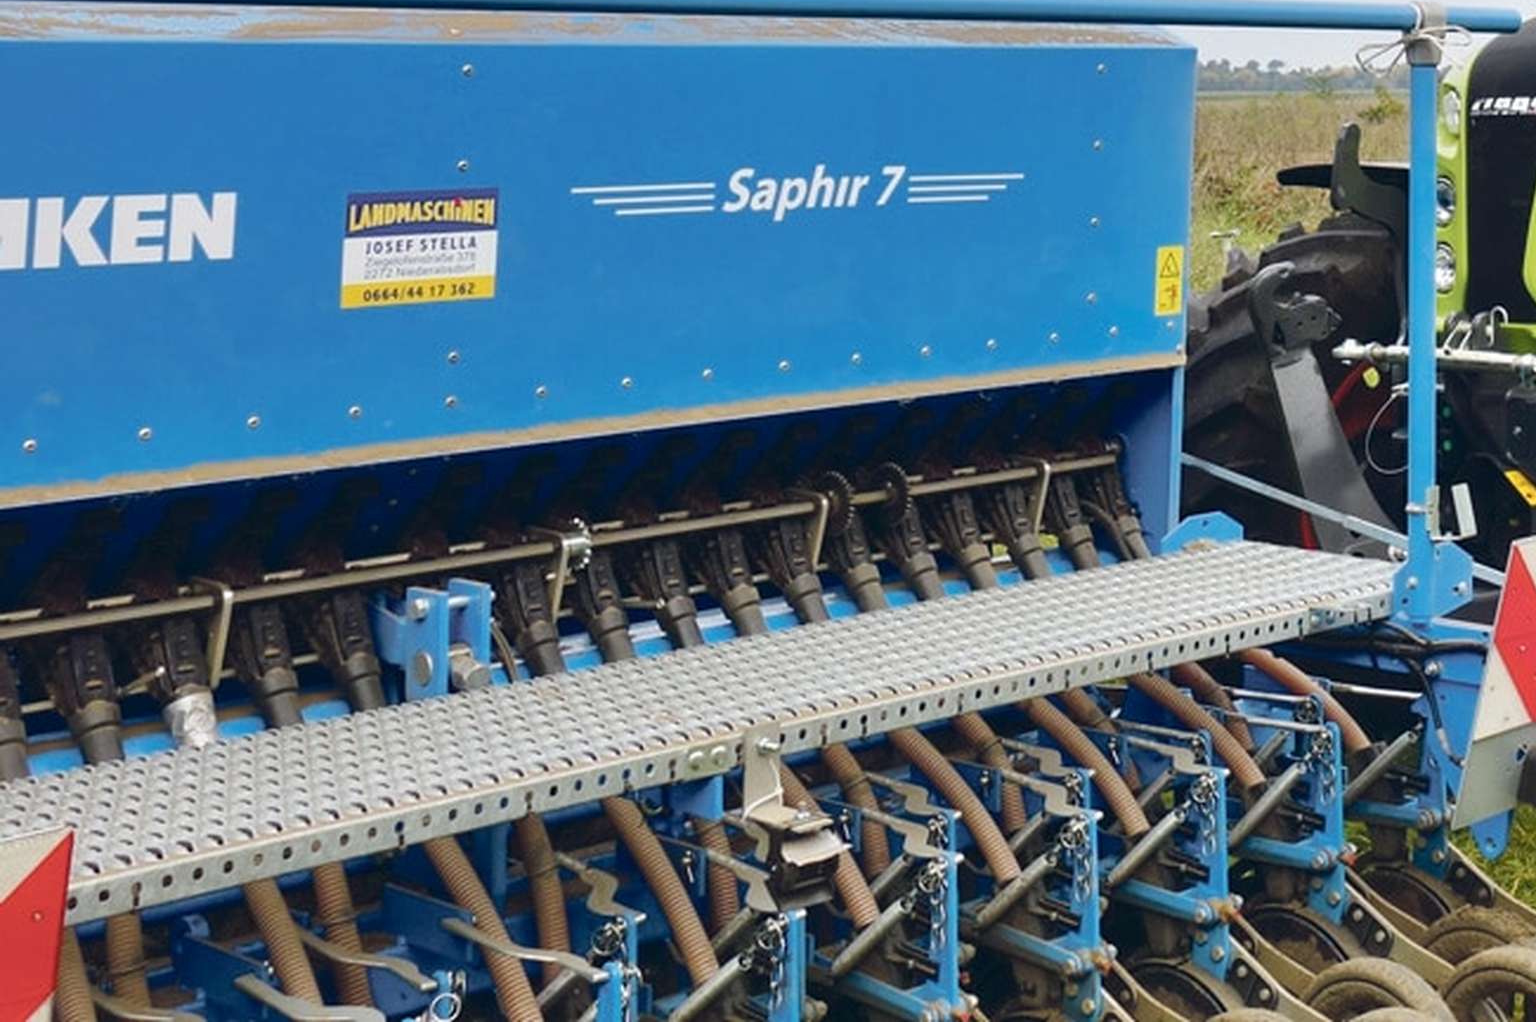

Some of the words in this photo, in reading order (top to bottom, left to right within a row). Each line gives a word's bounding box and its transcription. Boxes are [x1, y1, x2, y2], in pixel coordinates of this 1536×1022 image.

[722, 164, 870, 221] Saphir
[876, 165, 905, 206] 7
[365, 238, 415, 255] JOSEF
[419, 236, 477, 253] STELLA
[362, 286, 424, 302] 0664/44
[429, 284, 445, 297] 17
[450, 282, 476, 296] 362
